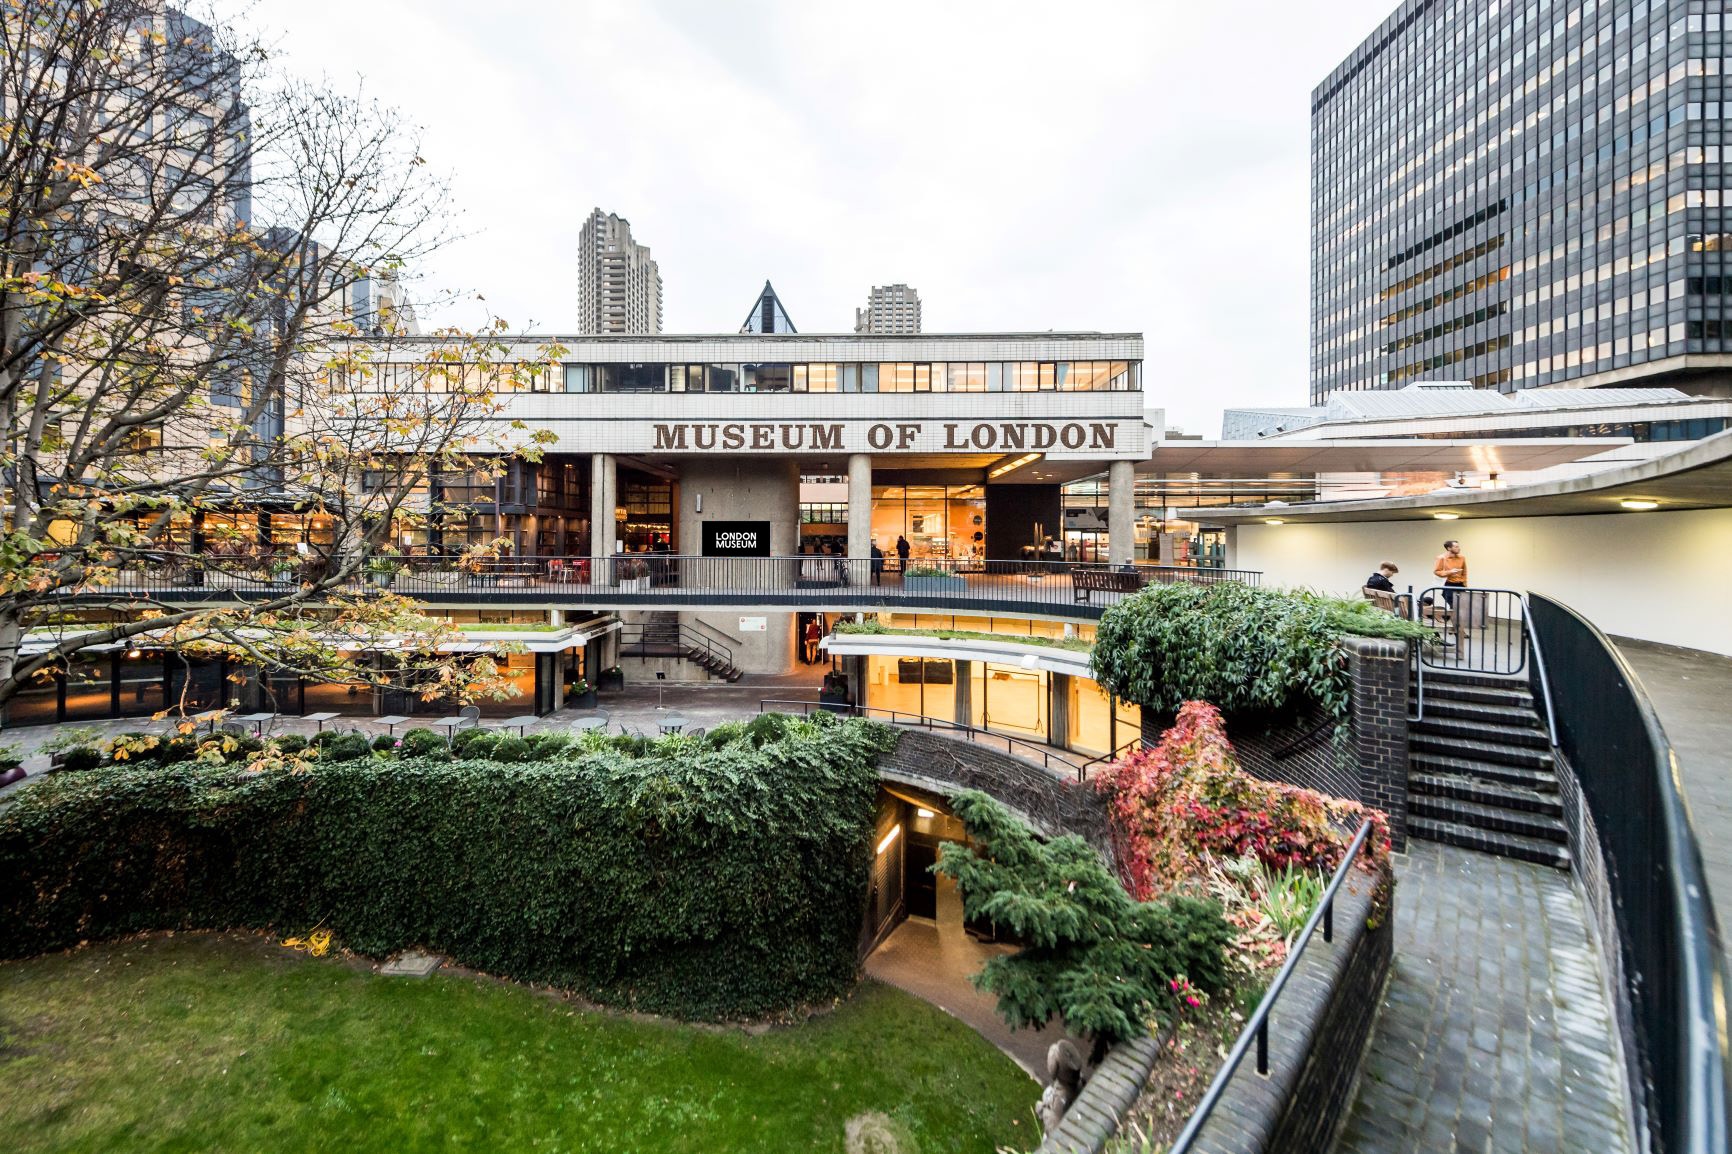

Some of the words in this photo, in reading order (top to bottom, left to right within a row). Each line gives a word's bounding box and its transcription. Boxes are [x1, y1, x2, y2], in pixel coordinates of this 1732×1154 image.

[653, 423, 846, 450] MUSEUM
[867, 422, 922, 450] OF
[943, 423, 1119, 450] LONDON
[715, 532, 757, 541] LONDON
[715, 540, 757, 549] MUSEUM
